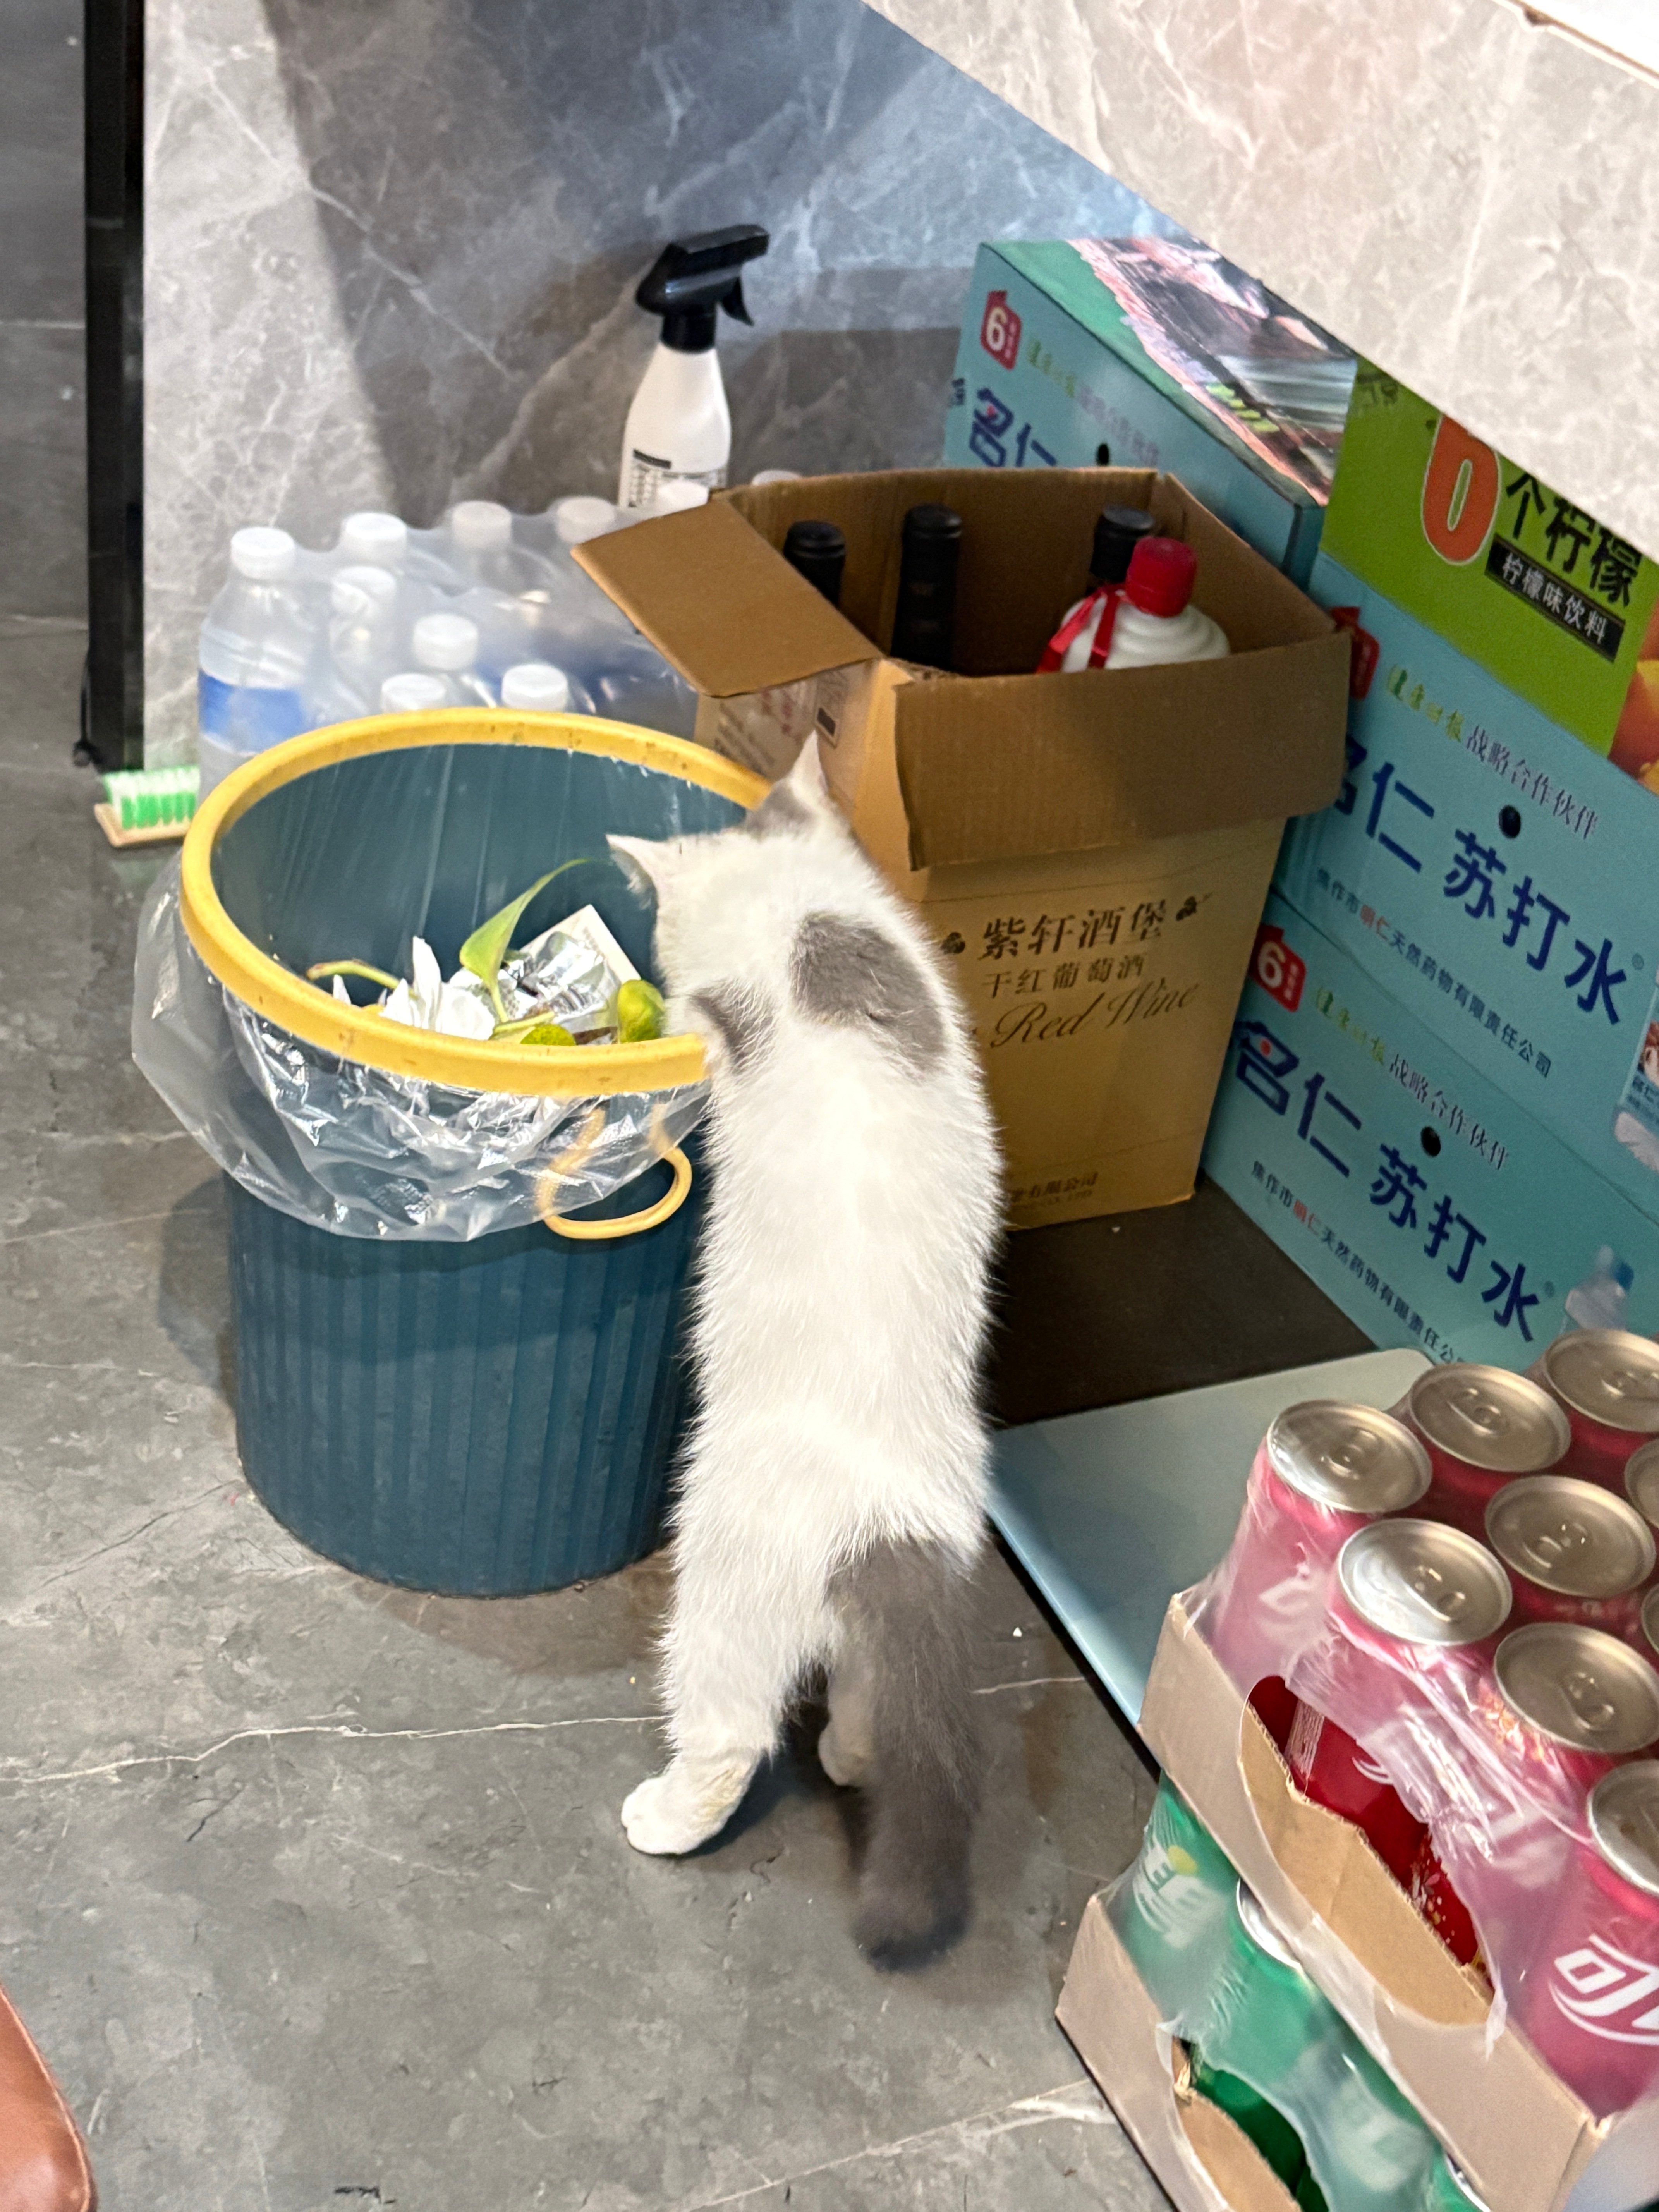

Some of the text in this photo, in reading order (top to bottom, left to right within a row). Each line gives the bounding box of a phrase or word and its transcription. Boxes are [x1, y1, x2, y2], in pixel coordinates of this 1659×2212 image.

[986, 307, 1008, 352] 6
[1503, 552, 1607, 644] 柠檬味饮料
[1467, 725, 1599, 840] 战略合作伙伴
[1334, 736, 1626, 1025] 仁苏打水
[977, 899, 1166, 960] 紫轩酒堡
[1258, 941, 1286, 989] 6
[982, 954, 1146, 999] 干红葡萄酒
[990, 977, 1200, 1048] Red Wine
[1389, 1053, 1508, 1171] 战略合作伙伴
